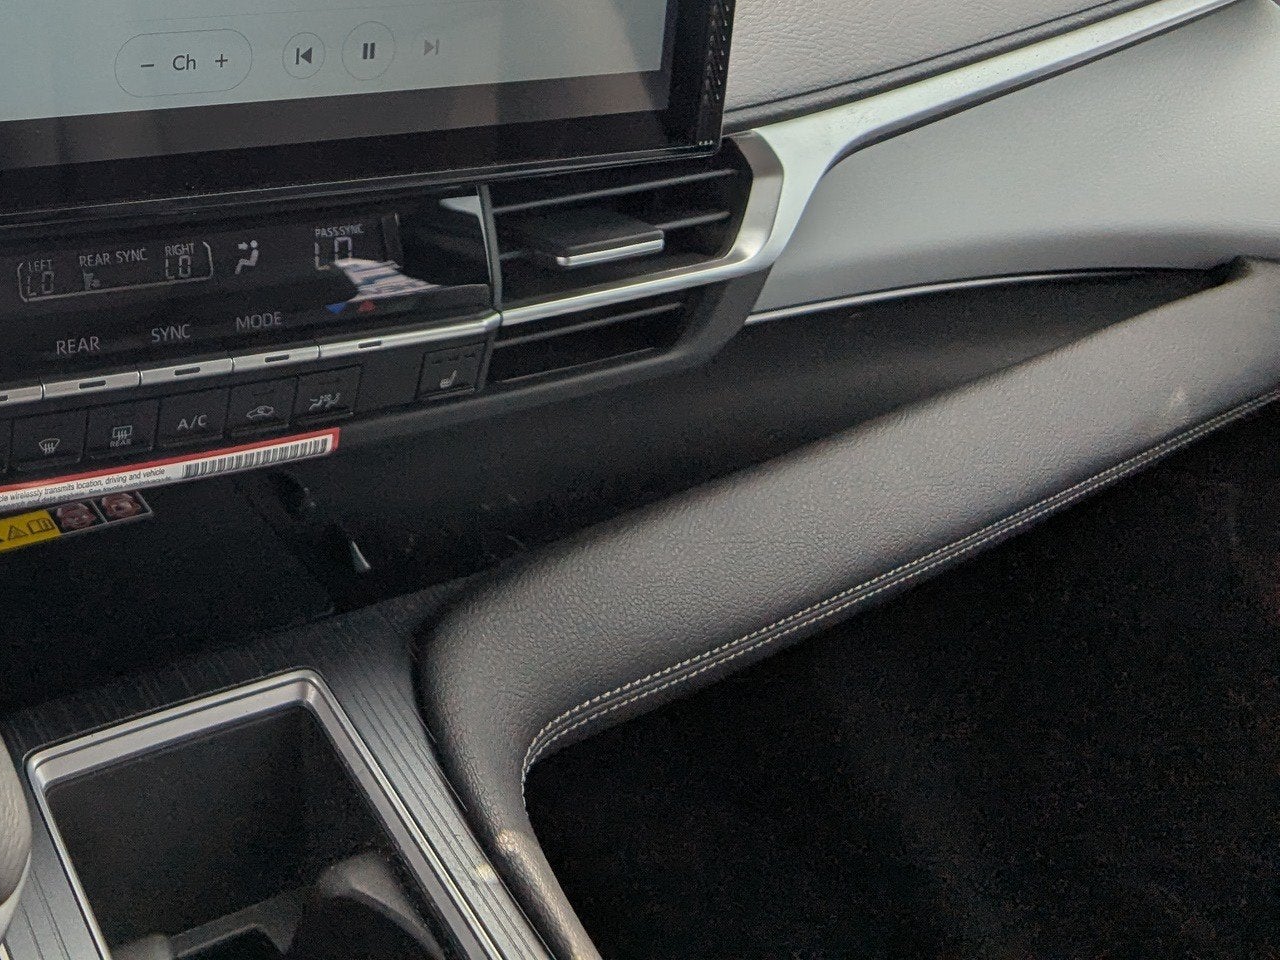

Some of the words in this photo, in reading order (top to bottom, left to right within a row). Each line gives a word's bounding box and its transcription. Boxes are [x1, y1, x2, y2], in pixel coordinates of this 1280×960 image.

[172, 54, 196, 71] Ch
[79, 252, 110, 268] REAR
[115, 247, 148, 264] SYNC
[164, 243, 194, 256] RIGHT
[28, 259, 53, 273] LEFT
[236, 311, 284, 333] MODE
[151, 324, 191, 343] SYNC
[56, 336, 101, 356] REAR
[177, 414, 208, 431] A/C
[110, 438, 132, 448] REAR
[10, 489, 42, 500] wirelessly
[44, 484, 74, 495] transmits
[105, 475, 127, 485] driving
[129, 472, 141, 480] and
[143, 467, 166, 478] vehicle
